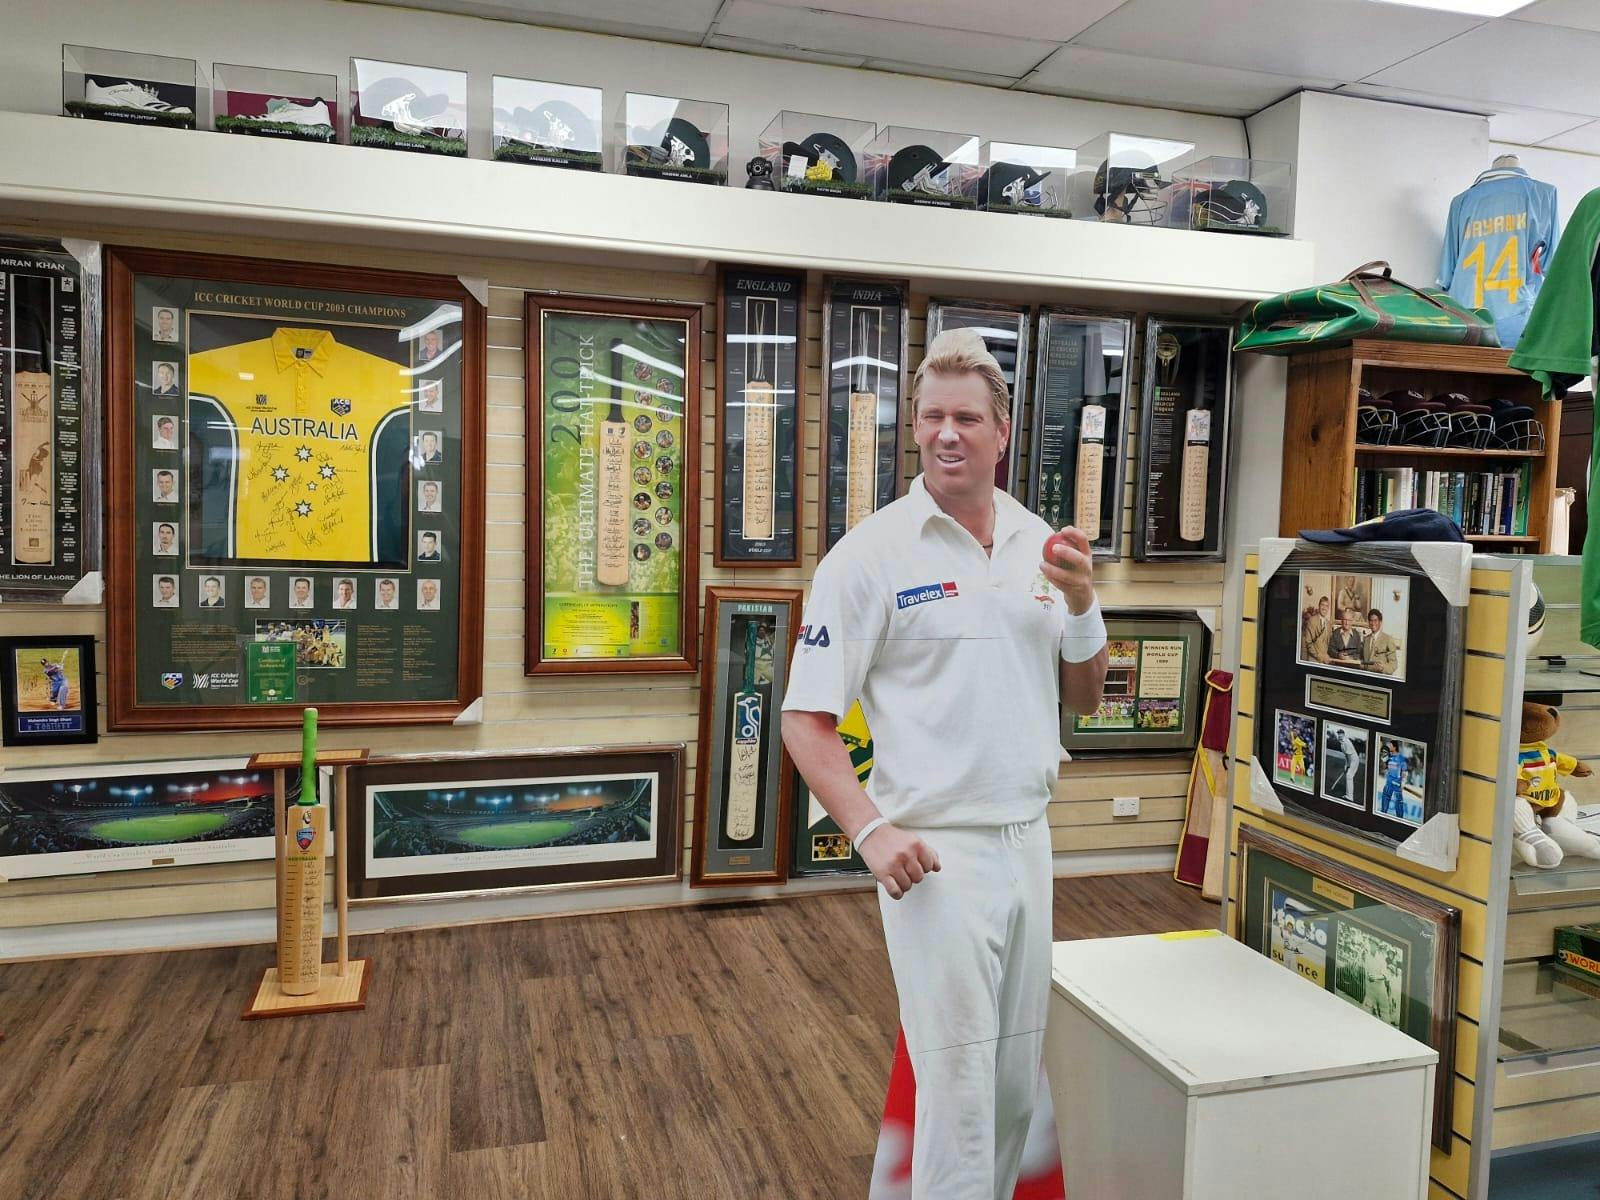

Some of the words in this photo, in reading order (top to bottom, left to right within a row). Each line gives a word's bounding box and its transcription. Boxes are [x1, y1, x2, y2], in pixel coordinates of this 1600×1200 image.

[104, 111, 129, 119] ANDREW
[0, 258, 31, 267] MRAN
[36, 261, 65, 271] KHAN
[1462, 235, 1523, 309] 14
[736, 279, 791, 292] ENGLAND
[852, 289, 882, 301] INDIA
[194, 292, 214, 303] ICC
[215, 293, 262, 307] CRICKET
[264, 297, 302, 310] WORLD
[303, 300, 324, 312] CUP
[325, 302, 345, 313] 2003
[346, 303, 407, 318] CHAMPIONS
[550, 326, 582, 446] 2007
[579, 335, 594, 437] HAT-TRICK
[251, 416, 359, 441] AUSTRALIA
[579, 447, 594, 540] ULTIMATE
[578, 551, 593, 587] THE
[737, 604, 773, 613] PAKISTAN
[897, 588, 943, 608] Travelex
[1569, 952, 1600, 973] WORL
